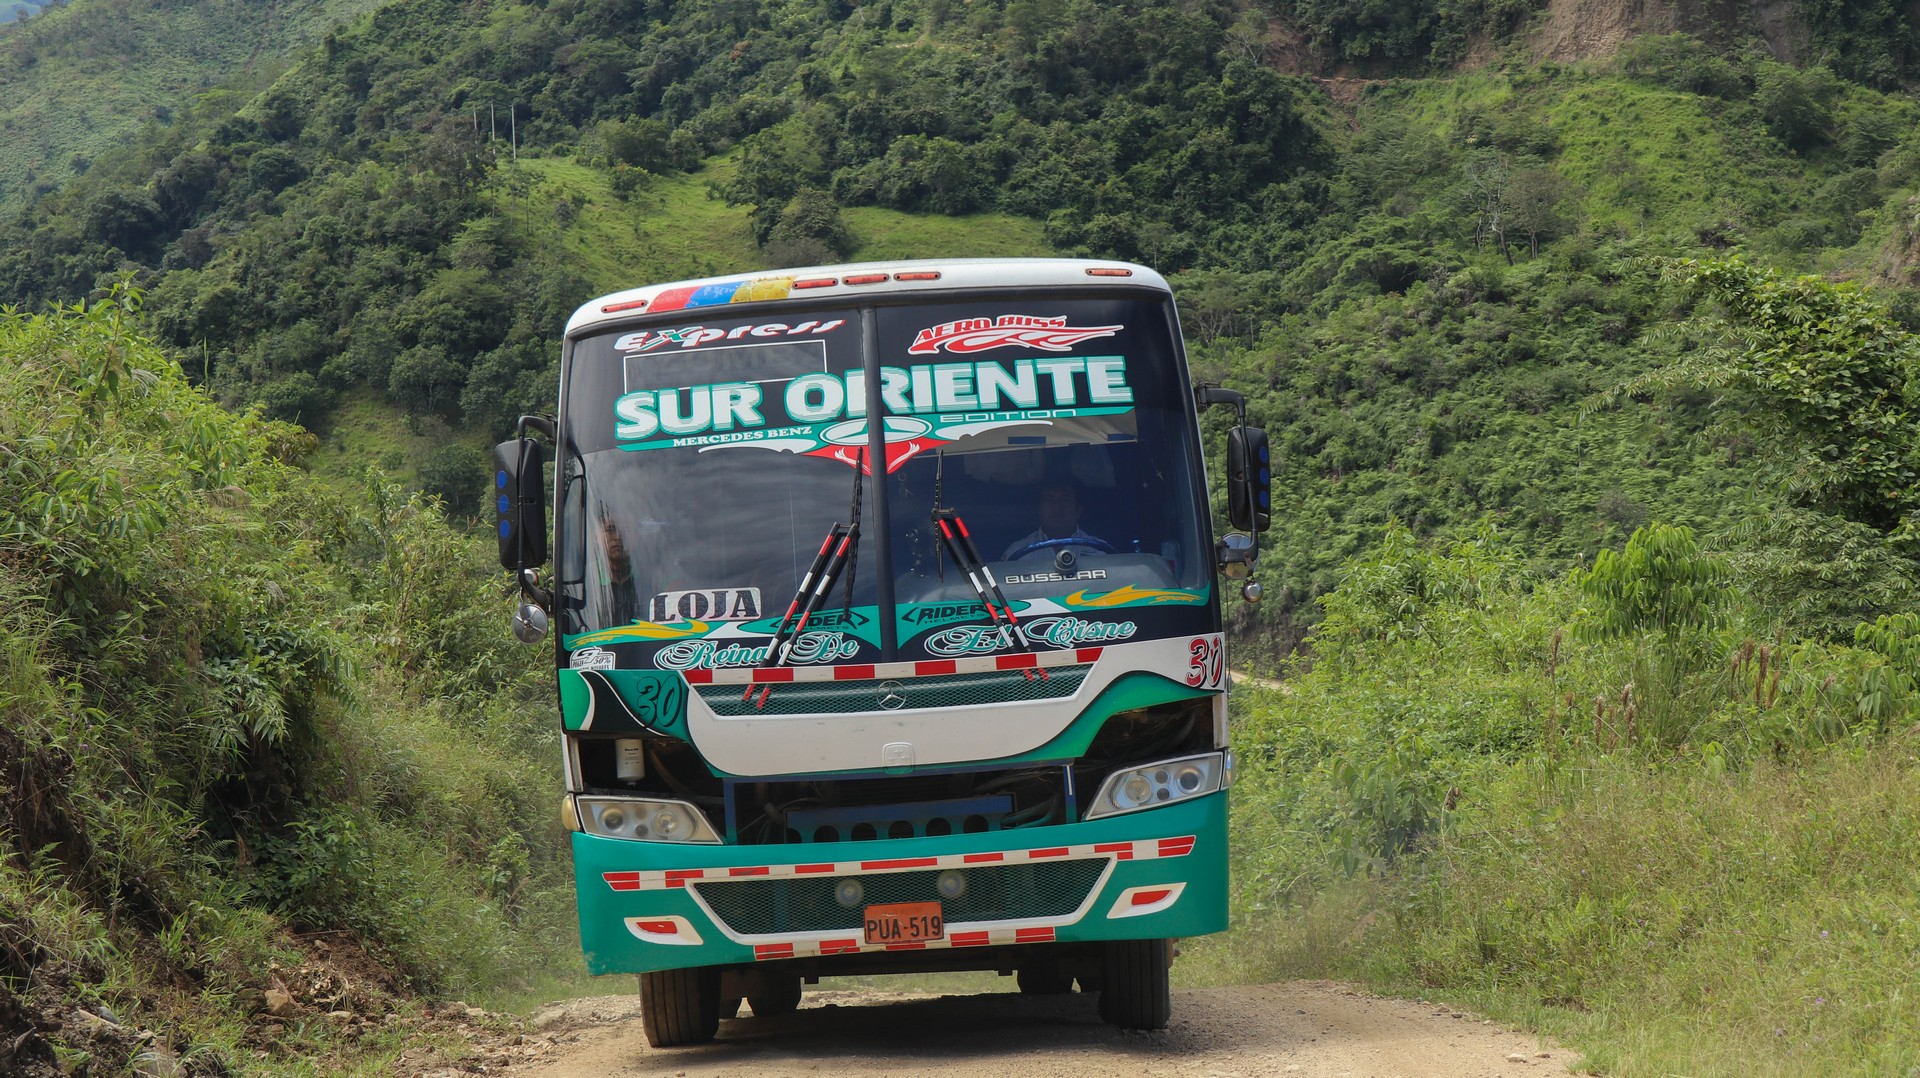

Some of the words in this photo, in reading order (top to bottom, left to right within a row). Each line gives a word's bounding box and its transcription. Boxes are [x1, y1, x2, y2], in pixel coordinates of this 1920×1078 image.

[614, 319, 845, 353] Express
[915, 318, 991, 341] AERO
[997, 315, 1067, 329] BUSS
[615, 382, 765, 440] SUR
[784, 355, 1134, 424] ORIENTE
[940, 409, 1077, 422] EDITION
[673, 430, 764, 447] MERCEDES
[767, 426, 812, 439] BENZ
[653, 590, 760, 621] LOJA
[916, 603, 991, 625] RIDER
[1022, 616, 1137, 650] Cisne
[653, 640, 769, 670] Reina
[779, 631, 860, 665] De
[1185, 635, 1223, 688] 30
[636, 674, 683, 728] 30
[866, 915, 941, 940] PUA-519
